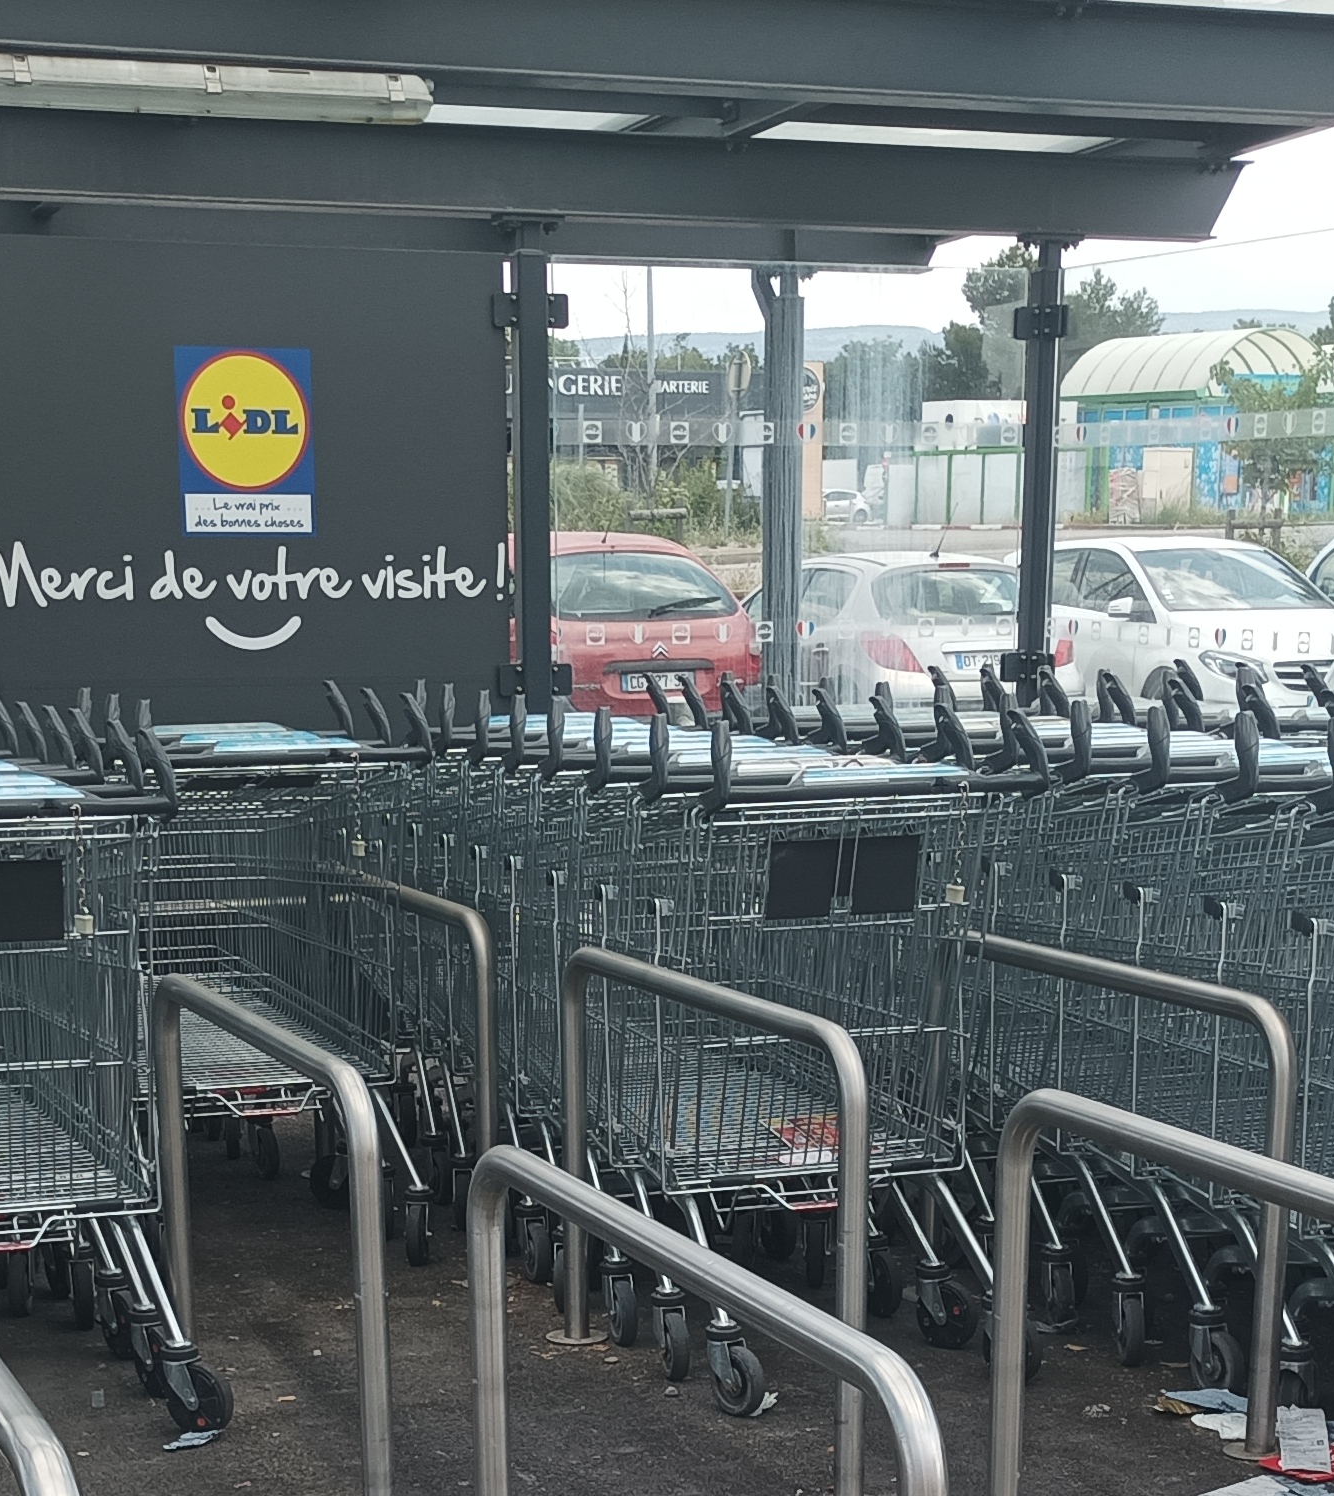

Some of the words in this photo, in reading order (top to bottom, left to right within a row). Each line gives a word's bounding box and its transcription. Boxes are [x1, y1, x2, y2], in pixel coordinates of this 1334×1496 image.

[548, 374, 622, 396] GERIE
[655, 380, 710, 394] ARTERIE
[212, 498, 232, 511] Le
[234, 499, 257, 511] vrai
[259, 499, 281, 515] prix
[194, 515, 217, 528] des
[220, 513, 261, 528] bonnes
[264, 515, 304, 528] choses
[150, 551, 218, 602] de
[226, 545, 354, 602] votre
